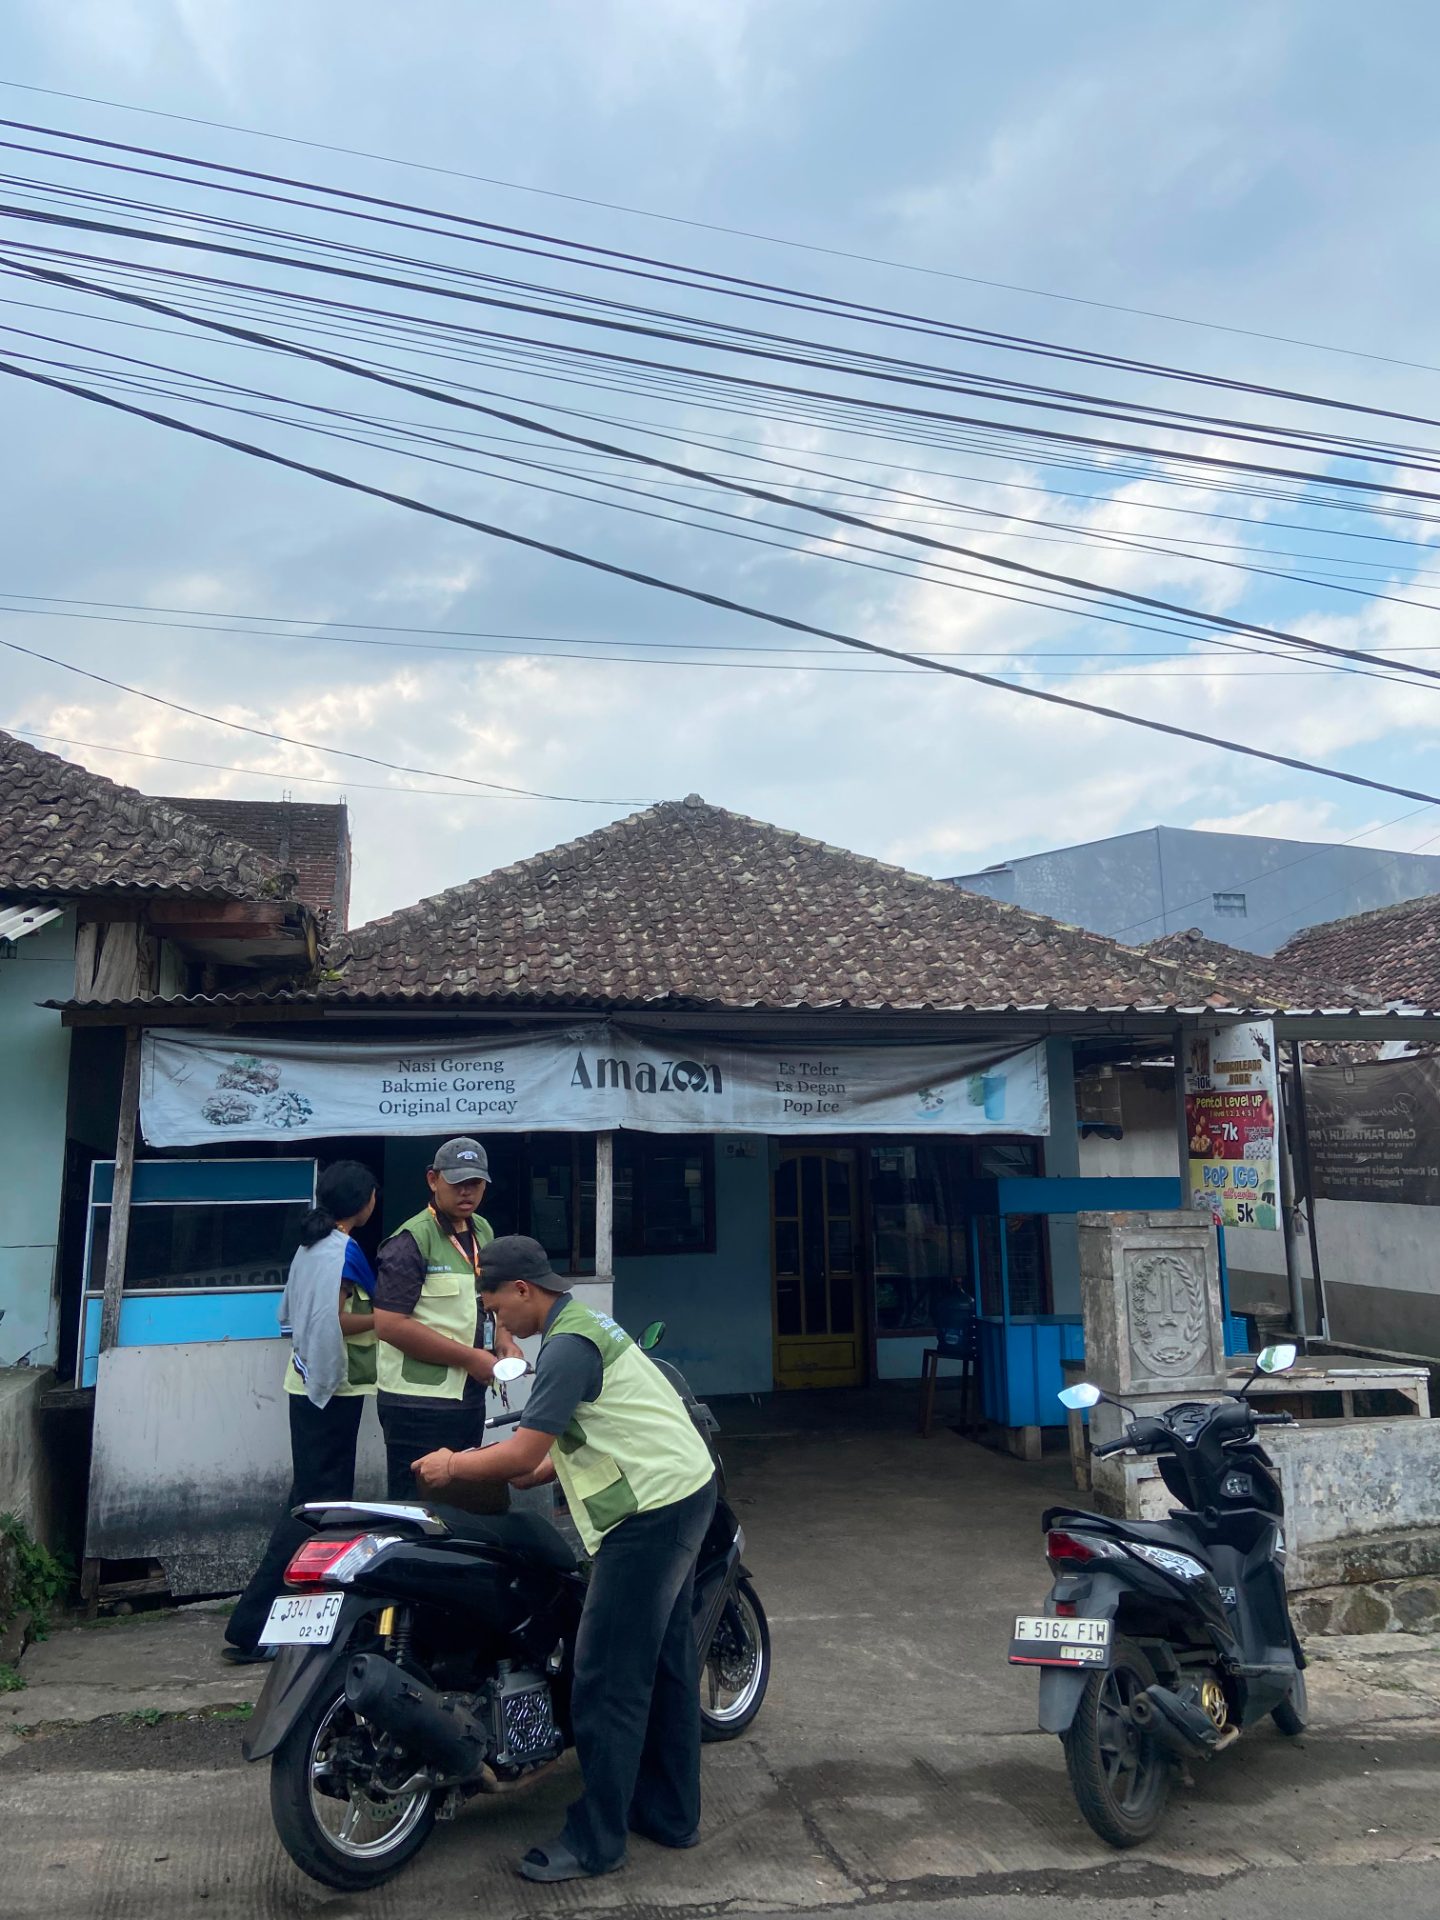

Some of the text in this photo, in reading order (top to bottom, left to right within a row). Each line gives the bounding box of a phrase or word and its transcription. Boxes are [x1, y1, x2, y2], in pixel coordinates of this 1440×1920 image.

[398, 1058, 504, 1074] Nasi Goreng
[571, 1051, 723, 1094] Amazon
[778, 1061, 839, 1076] Es Teler
[382, 1077, 515, 1094] Bakmie Goreng
[775, 1080, 846, 1096] Es Degan
[379, 1098, 517, 1117] Original Capcay
[783, 1099, 840, 1115] Pop Ice
[1221, 1121, 1239, 1141] 7k
[1202, 1164, 1228, 1188] POP
[1237, 1202, 1254, 1223] 5k
[1017, 1620, 1106, 1641] F 5164 FIW
